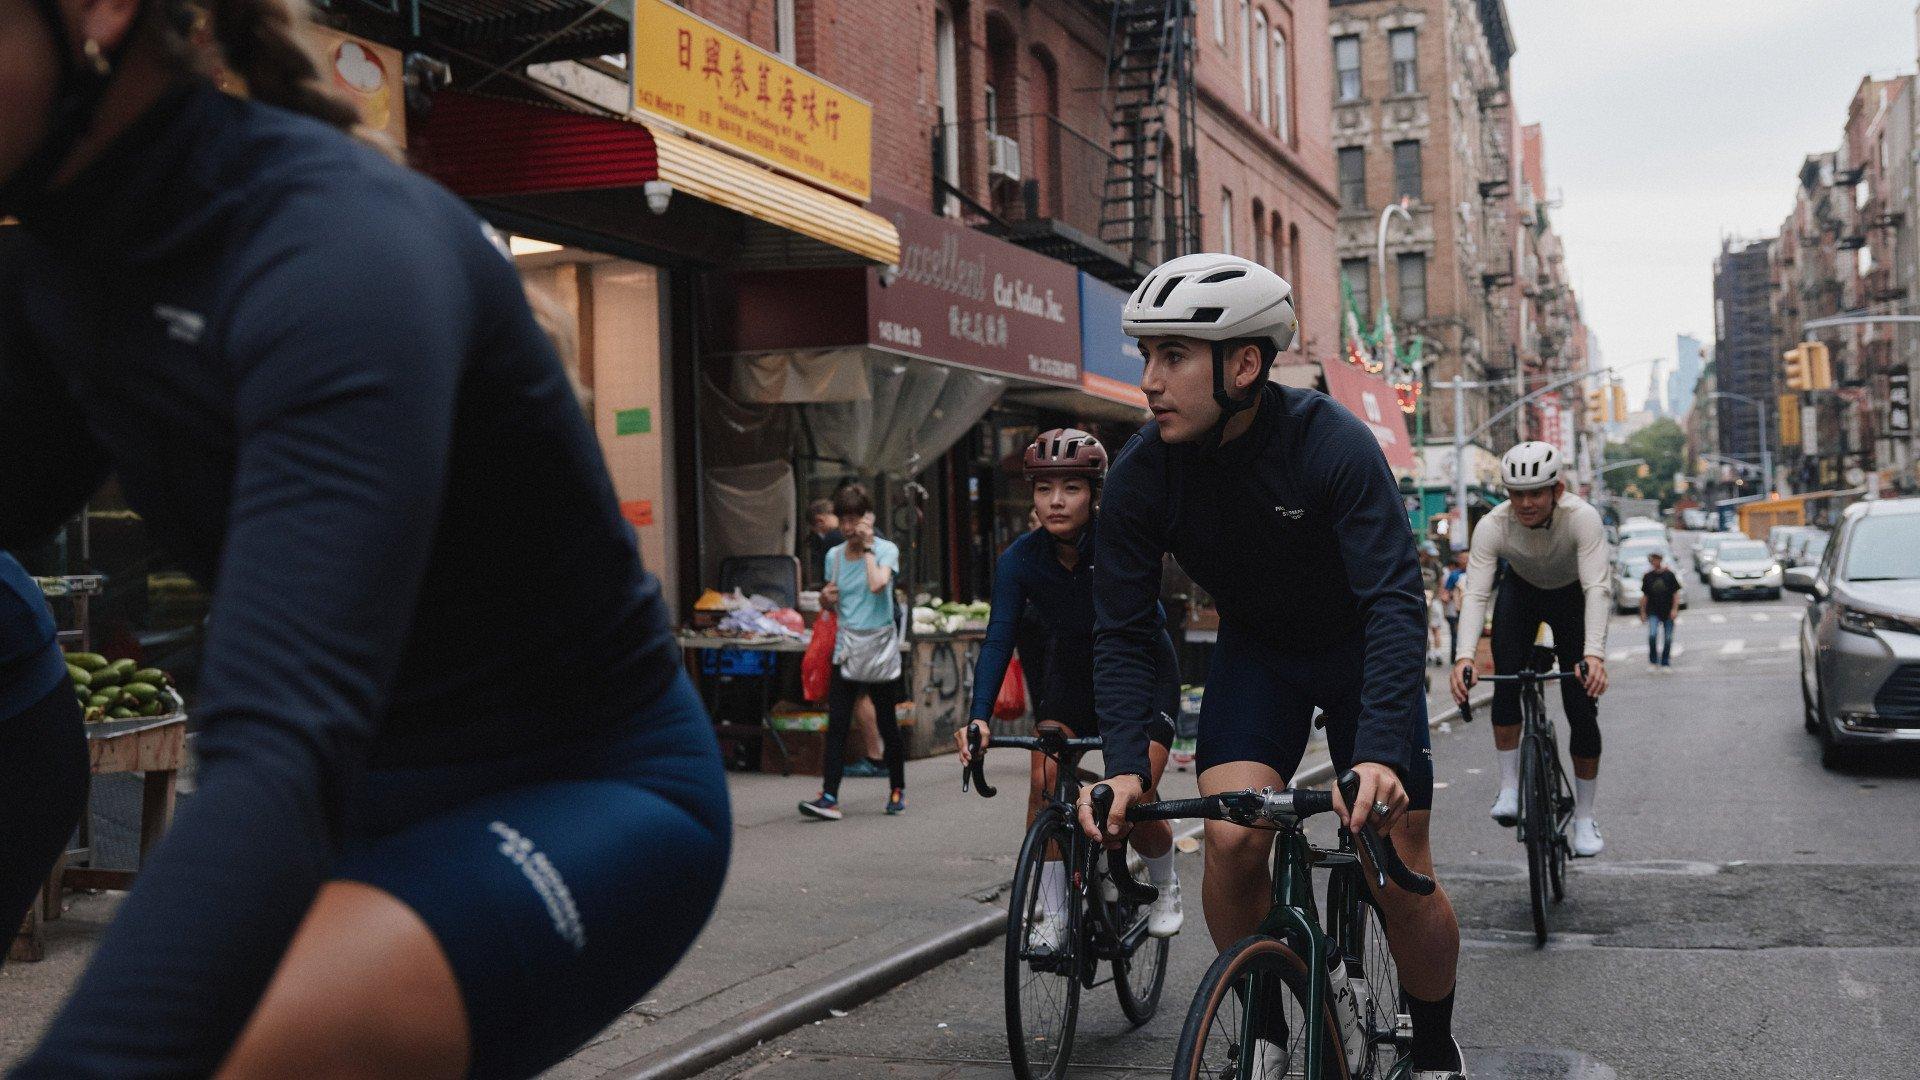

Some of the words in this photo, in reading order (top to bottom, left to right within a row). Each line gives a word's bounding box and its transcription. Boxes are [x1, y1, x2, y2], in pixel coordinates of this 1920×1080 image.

[897, 217, 987, 301] xcellent
[993, 272, 1013, 308] Cut
[1014, 279, 1044, 318] Salon
